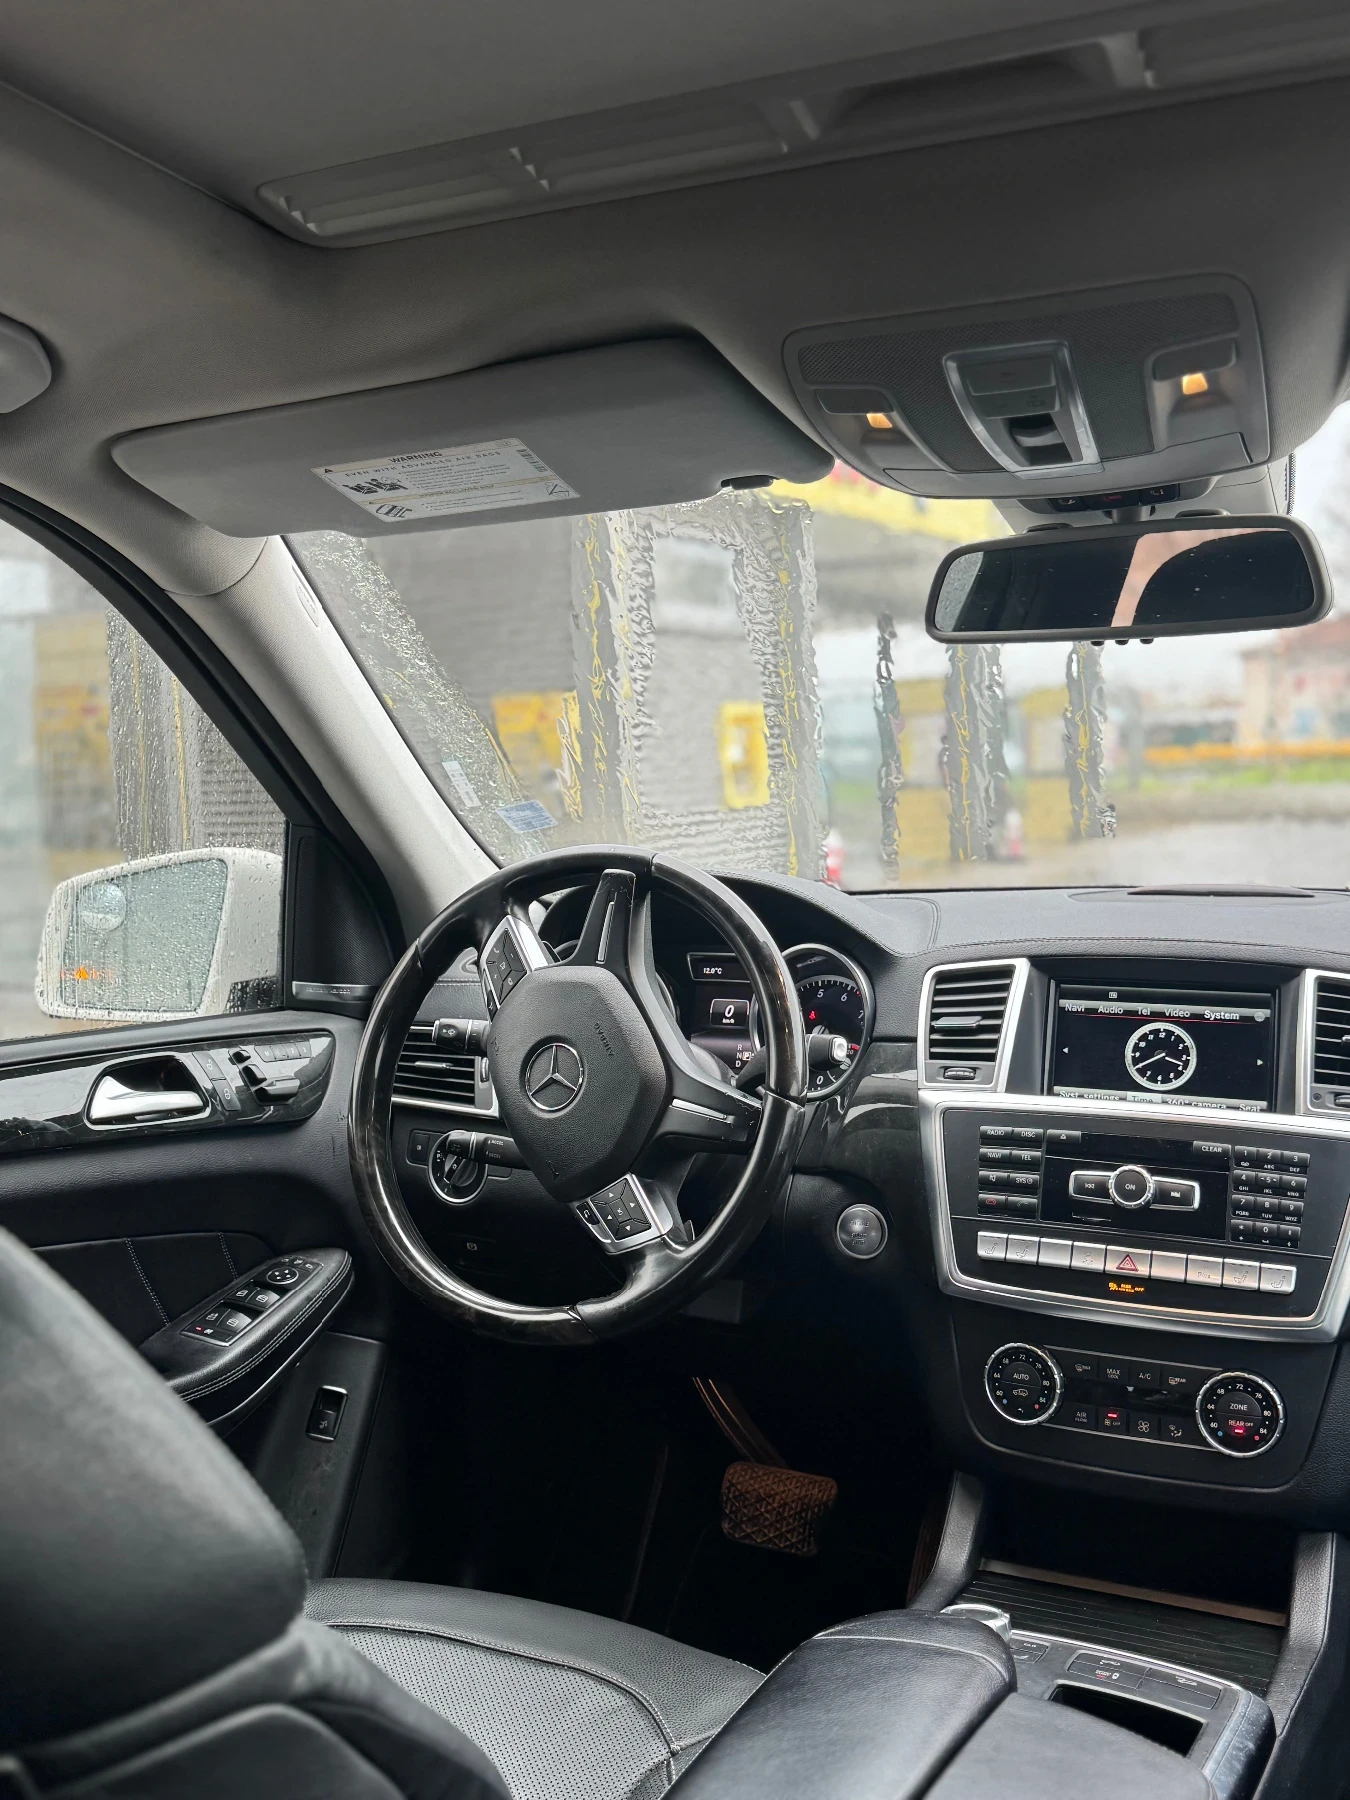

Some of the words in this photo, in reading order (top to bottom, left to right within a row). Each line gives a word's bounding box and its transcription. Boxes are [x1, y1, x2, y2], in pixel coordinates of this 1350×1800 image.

[388, 451, 442, 463] WARNING
[402, 459, 452, 469] ADVANCED
[817, 989, 824, 998] 5
[840, 993, 847, 1001] 6
[724, 1004, 734, 1017] 0
[858, 1010, 864, 1018] 7
[1065, 1002, 1085, 1012] Navi
[1098, 1005, 1124, 1014] Audio
[1137, 1006, 1150, 1016] Tel
[1164, 1008, 1190, 1018] Video
[1204, 1010, 1240, 1021] System
[816, 1076, 823, 1084] 0
[1239, 1103, 1260, 1112] Seat
[1201, 1145, 1223, 1153] CLEAR
[1230, 1403, 1248, 1411] ZONE
